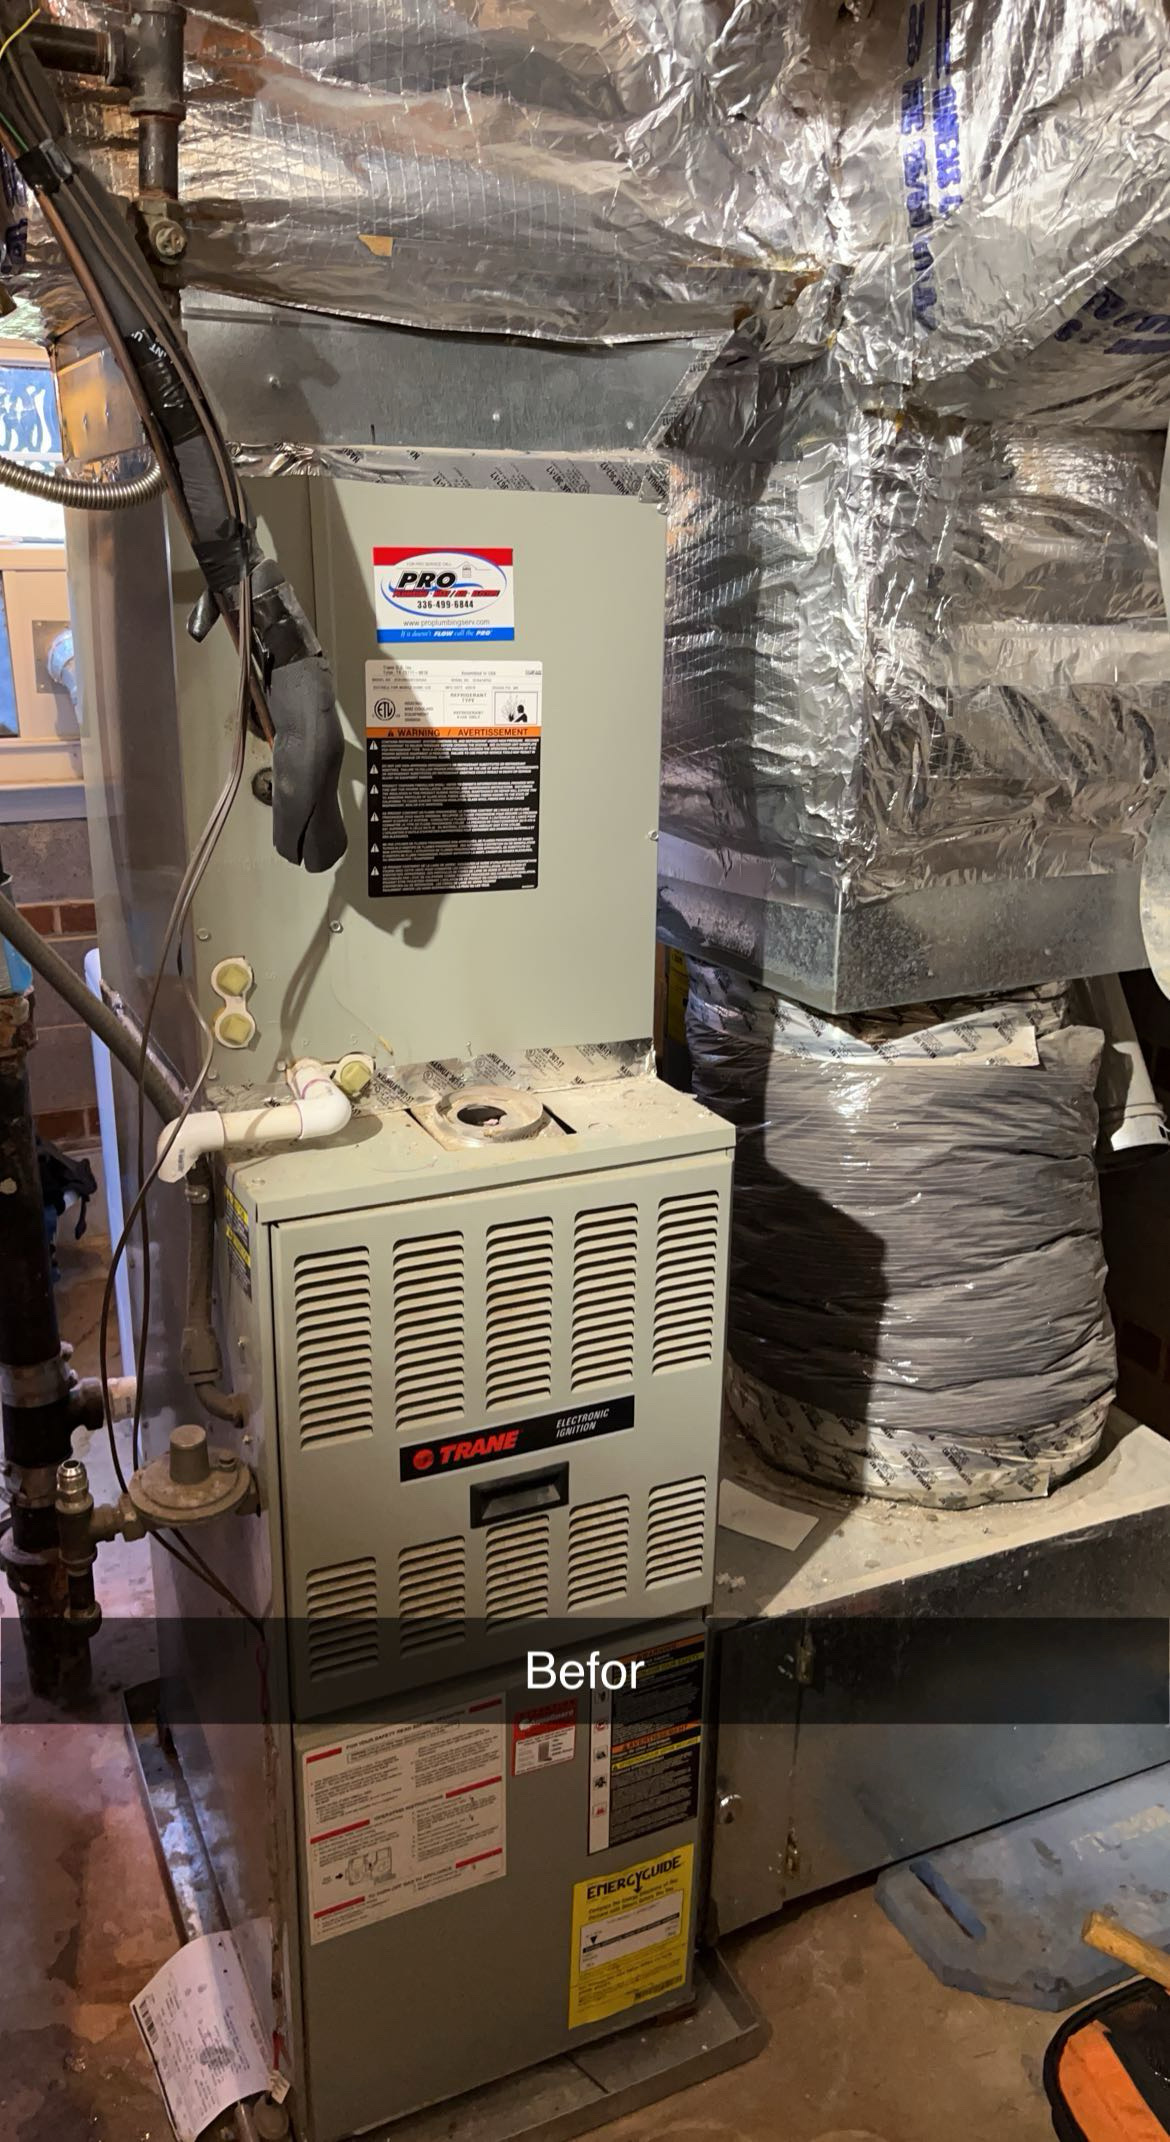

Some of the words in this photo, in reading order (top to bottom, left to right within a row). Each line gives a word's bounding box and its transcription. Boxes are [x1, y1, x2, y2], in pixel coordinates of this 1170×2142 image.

[398, 572, 457, 589] PRO
[417, 600, 474, 609] 336-499-6844
[397, 728, 441, 738] WARNING
[457, 728, 529, 737] AVERTISSEMENT
[556, 1408, 610, 1429] ELECTRONIC
[556, 1421, 597, 1439] IGNITION
[439, 1430, 520, 1465] TRANE
[374, 1731, 396, 1742] SAFETY
[586, 1854, 682, 1900] ENERGYGUIDE
